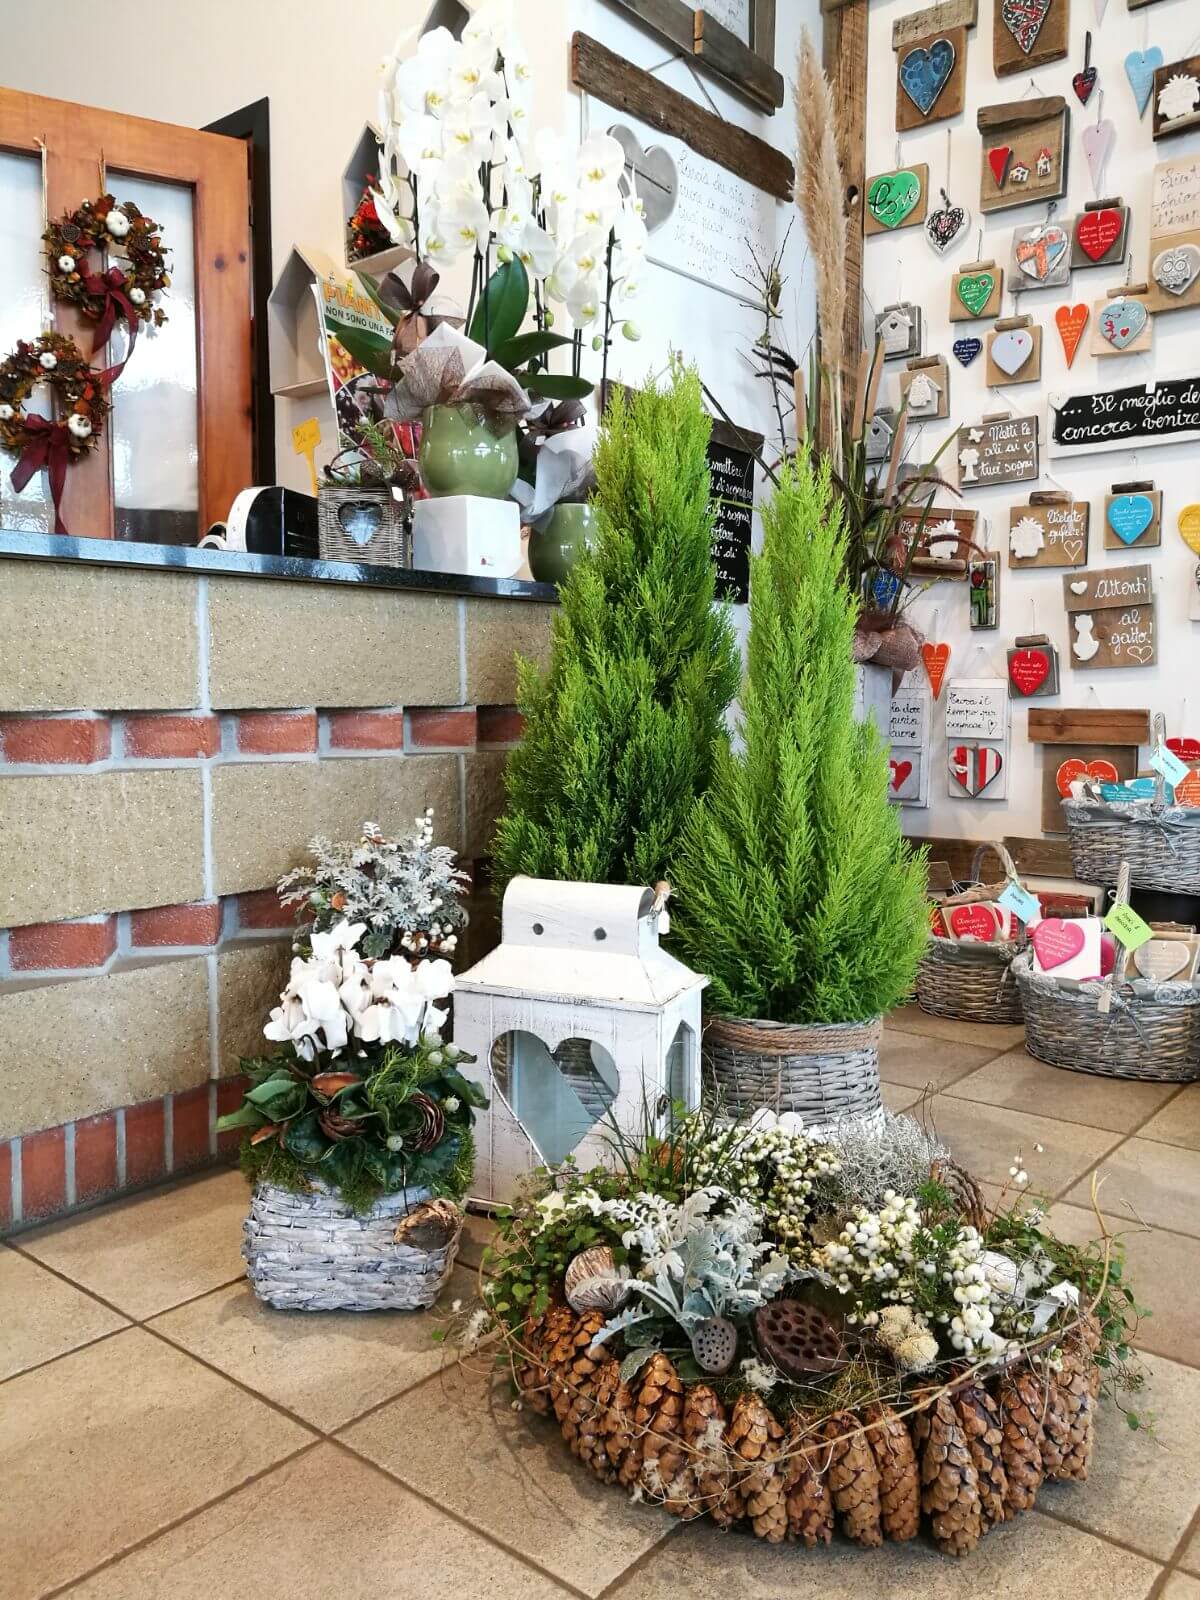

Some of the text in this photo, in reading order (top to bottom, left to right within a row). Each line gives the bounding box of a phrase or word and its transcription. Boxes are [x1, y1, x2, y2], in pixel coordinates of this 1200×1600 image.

[325, 305, 344, 319] NON
[345, 312, 367, 327] SONO
[367, 320, 386, 334] UNA
[1119, 387, 1176, 417] meglio
[1061, 420, 1137, 440] ancora
